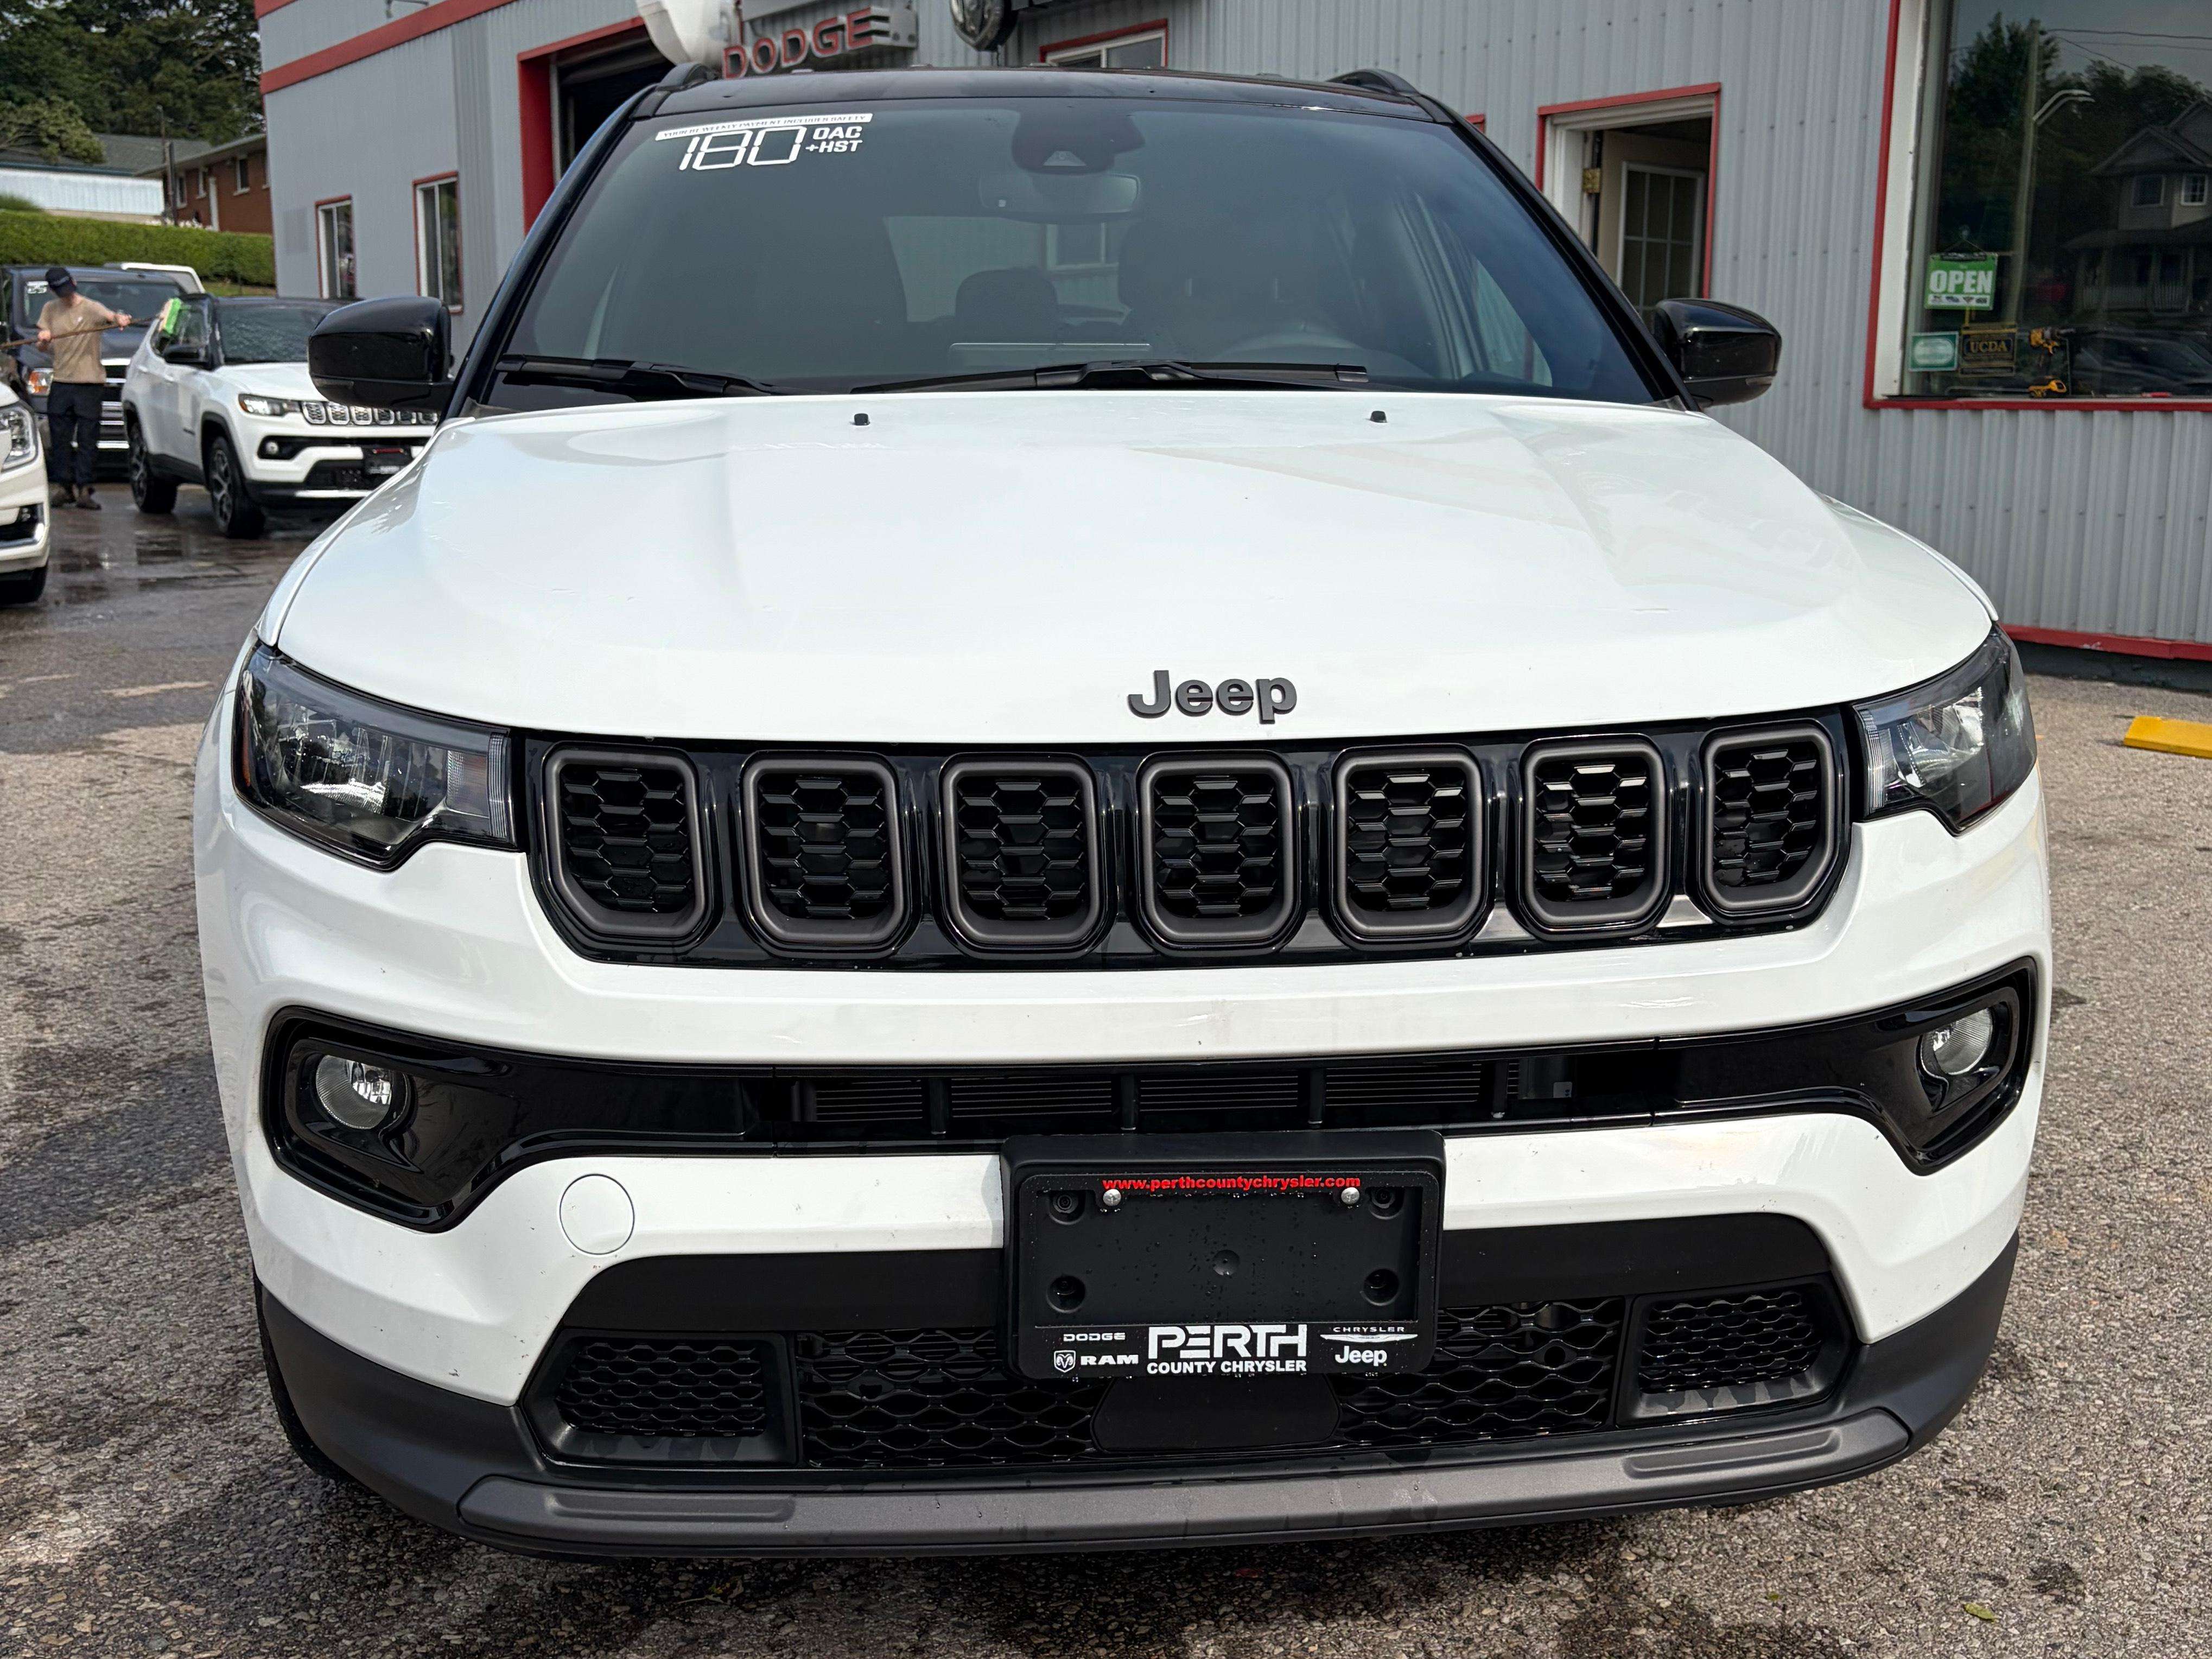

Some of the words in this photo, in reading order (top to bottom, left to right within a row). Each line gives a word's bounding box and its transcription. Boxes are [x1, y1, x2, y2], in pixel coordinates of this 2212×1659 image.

[721, 7, 874, 80] DODGE
[813, 126, 863, 140] OAC
[679, 126, 807, 170] 180
[805, 139, 863, 153] +HST
[1929, 270, 1993, 293] OPEN
[1969, 340, 2007, 353] UCDA
[1128, 670, 1298, 724] Jeep
[1102, 1175, 1361, 1192] www.perthcountychrysler.com
[1063, 1332, 1126, 1342] DODGE
[1148, 1324, 1307, 1359] PERTH
[1080, 1354, 1139, 1365] RAM
[1335, 1345, 1388, 1366] Jeep
[1147, 1361, 1216, 1374] COUNTY
[1221, 1360, 1307, 1373] CHRYSLER
